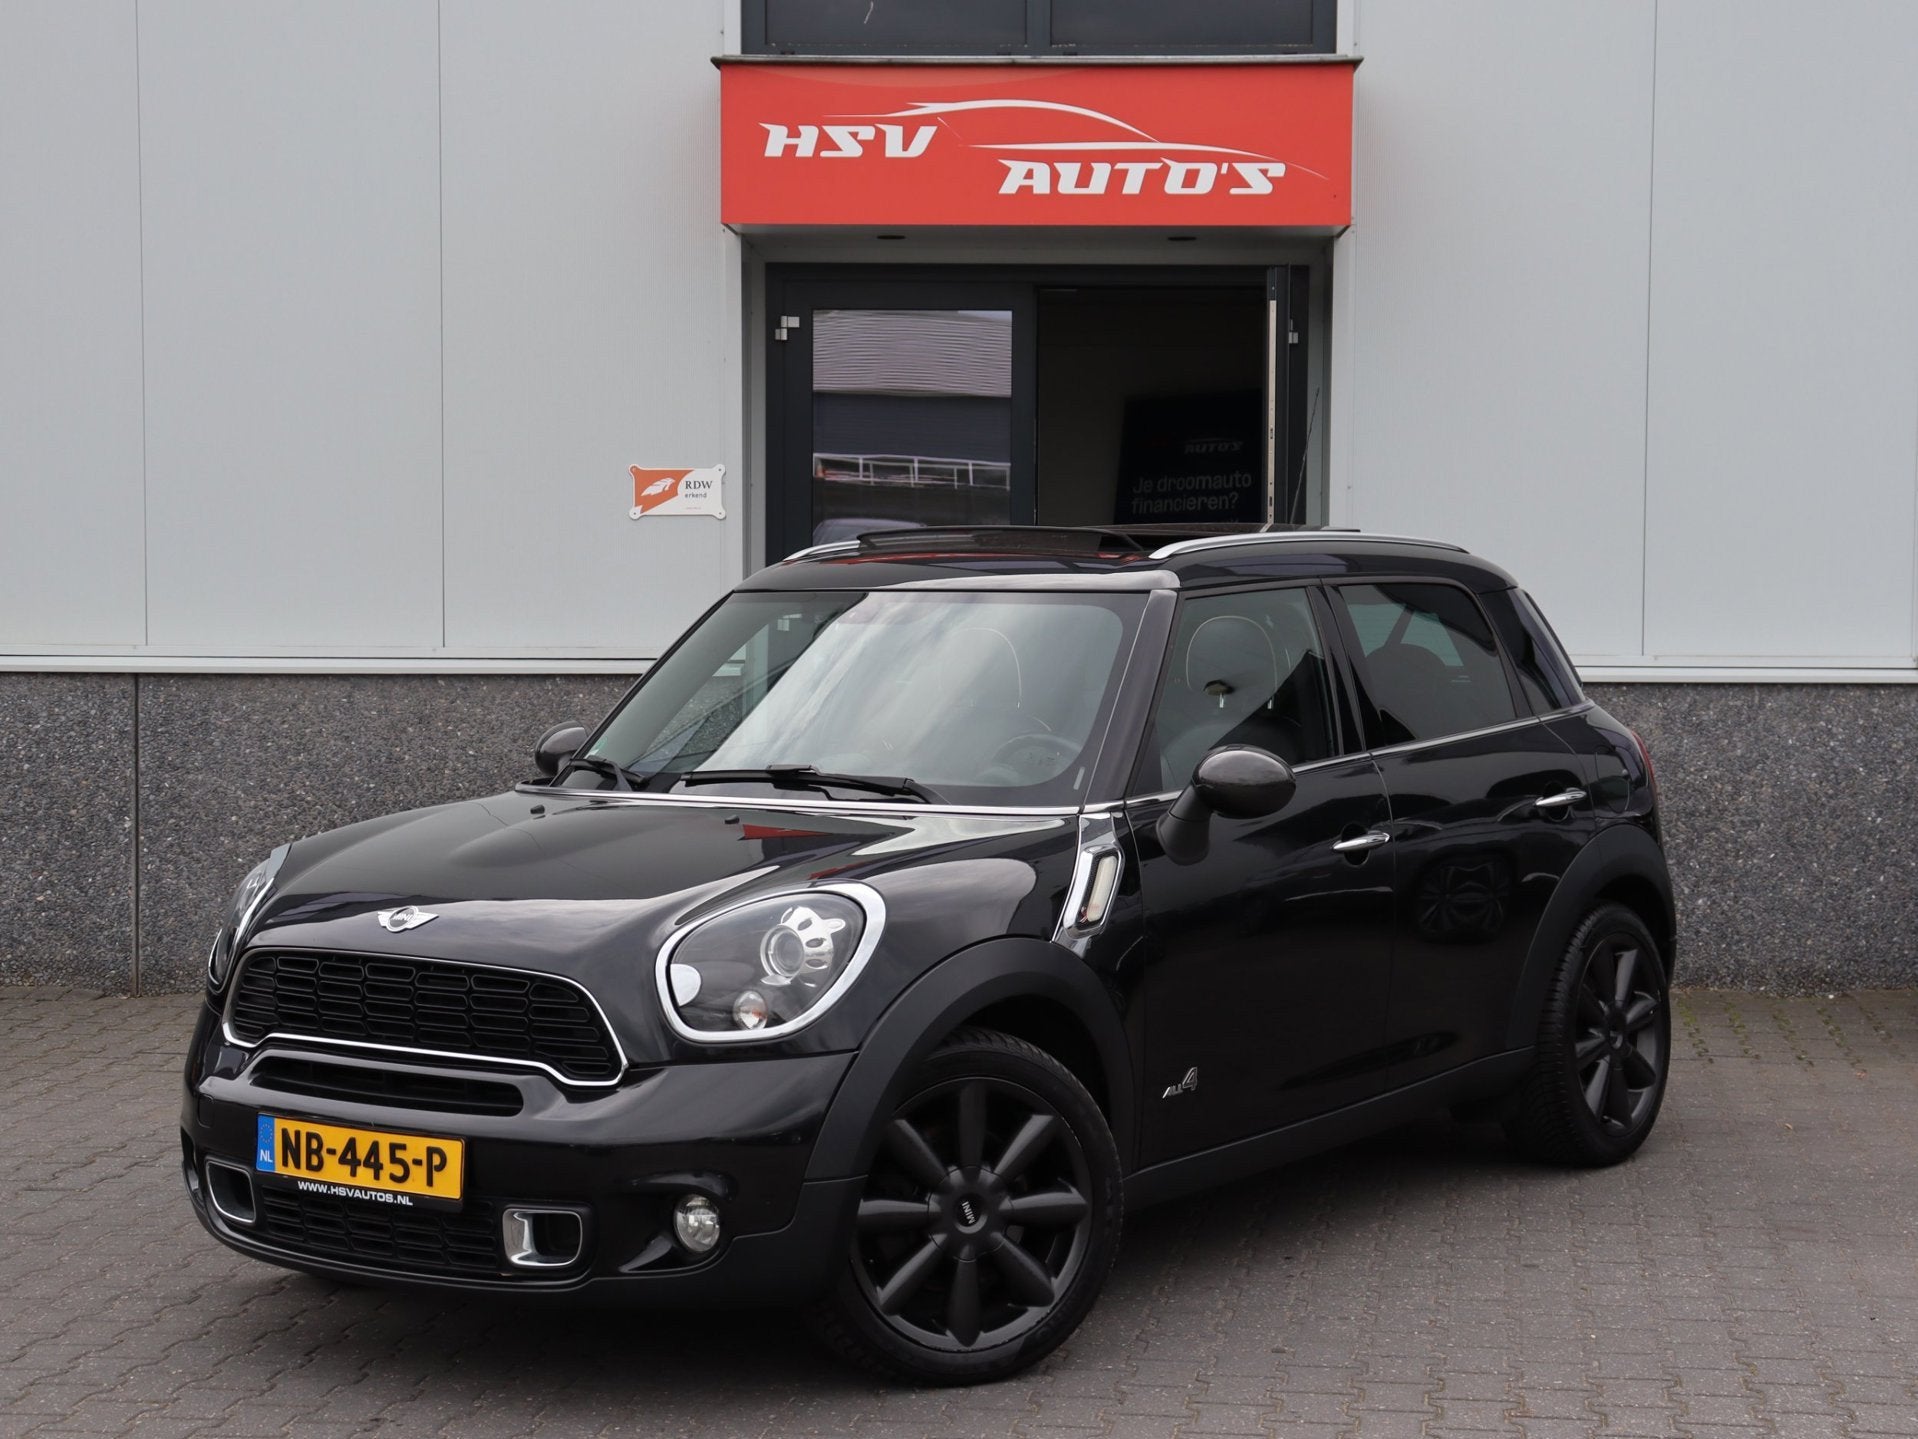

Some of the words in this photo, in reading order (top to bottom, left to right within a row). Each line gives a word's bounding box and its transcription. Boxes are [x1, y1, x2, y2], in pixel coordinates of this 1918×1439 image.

[758, 122, 937, 158] HSV
[998, 156, 1286, 195] AUTO'S
[685, 480, 713, 489] RDW
[1133, 478, 1153, 493] Je
[1157, 470, 1252, 492] droomauto
[1131, 492, 1239, 515] financieren?
[259, 1149, 273, 1163] NL
[281, 1127, 447, 1187] NB-445-P
[297, 1180, 414, 1206] WWW.HSVAUTOS.NL
